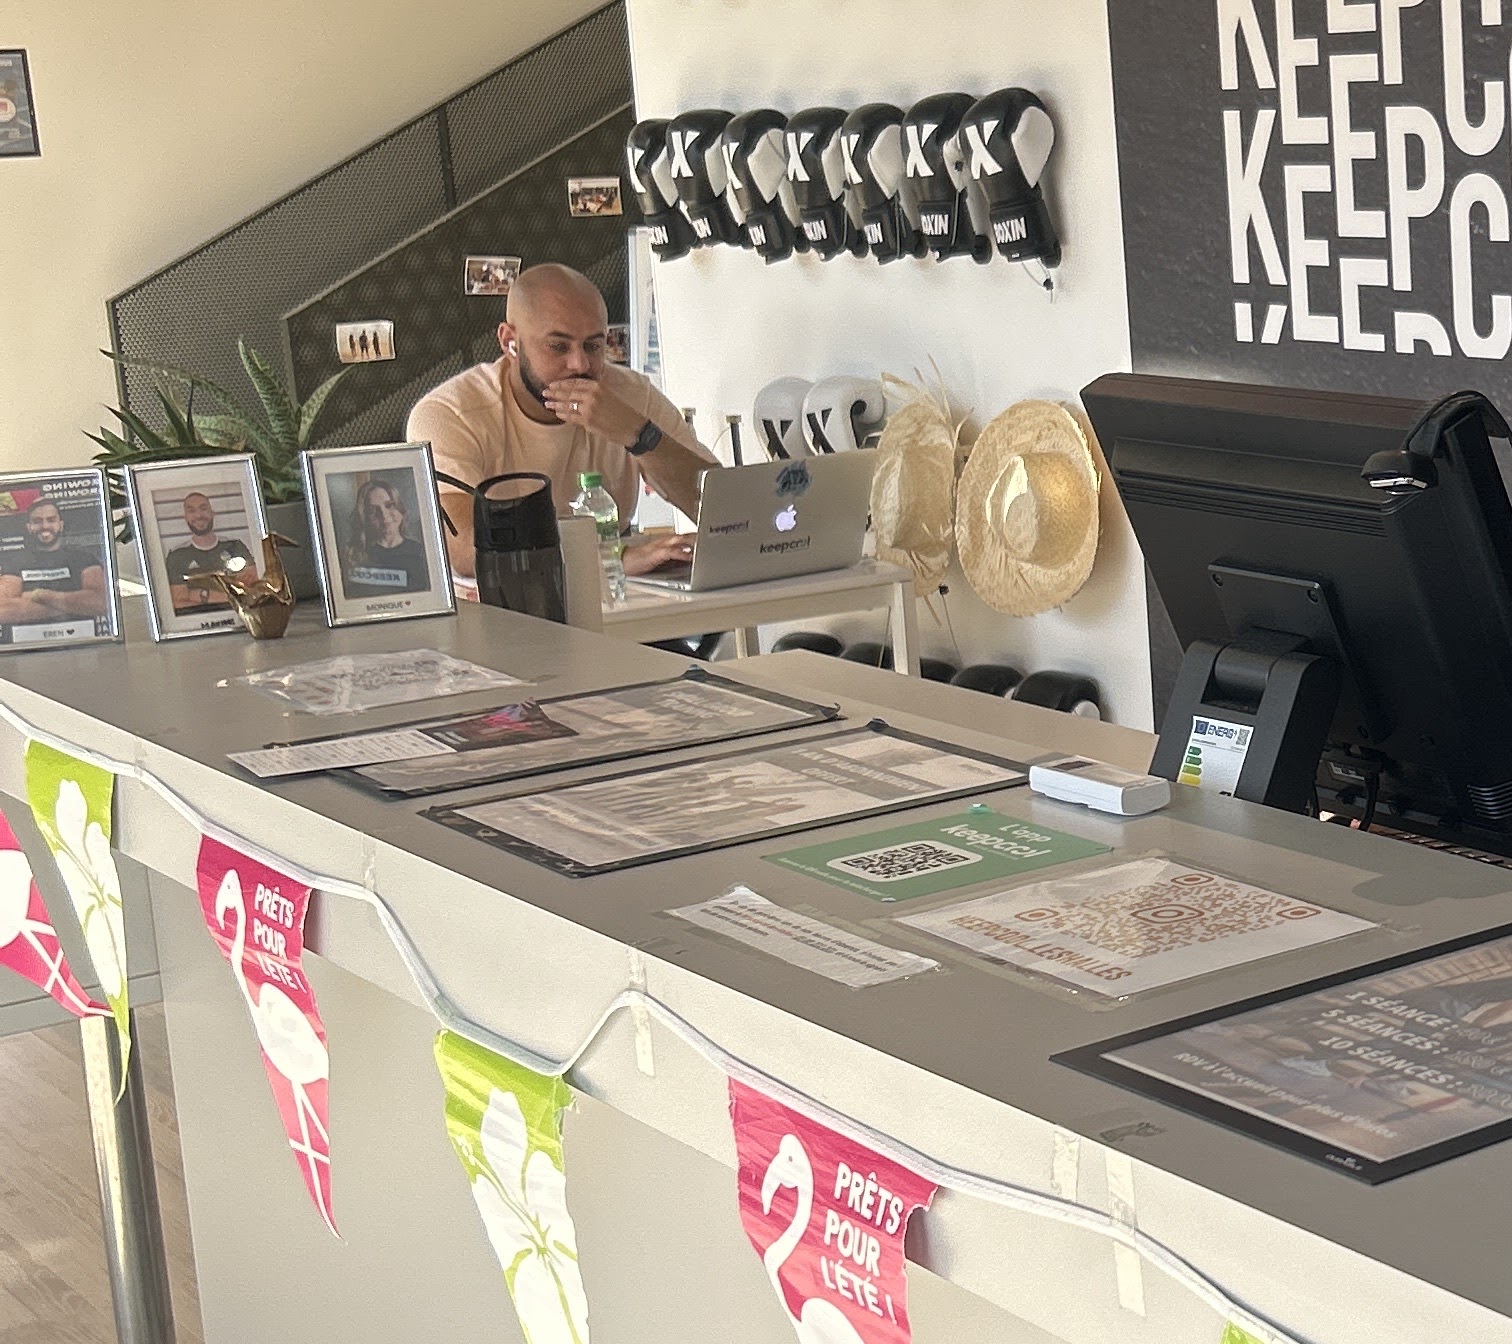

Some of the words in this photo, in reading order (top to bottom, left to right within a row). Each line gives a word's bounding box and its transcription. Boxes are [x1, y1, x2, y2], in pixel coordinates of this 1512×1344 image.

[759, 536, 811, 554] keepcool
[366, 601, 403, 611] MONIQUE
[940, 823, 1053, 858] keepcool
[999, 823, 1052, 844] L'app
[254, 882, 295, 929] PRÊTS
[253, 918, 288, 963] POUR
[1320, 1008, 1345, 1018] 5
[1338, 1013, 1441, 1050] SÉANCES
[1345, 991, 1368, 1001] 1
[1361, 995, 1451, 1028] SÉANCE
[1173, 1052, 1210, 1068] RDV
[1318, 1036, 1354, 1050] 10
[1347, 1045, 1454, 1085] SÉANCES
[834, 1161, 904, 1235] PRÊTS
[823, 1208, 881, 1278] POUR
[820, 1255, 884, 1317] L'ÉTÉ
[885, 1294, 898, 1325] !
